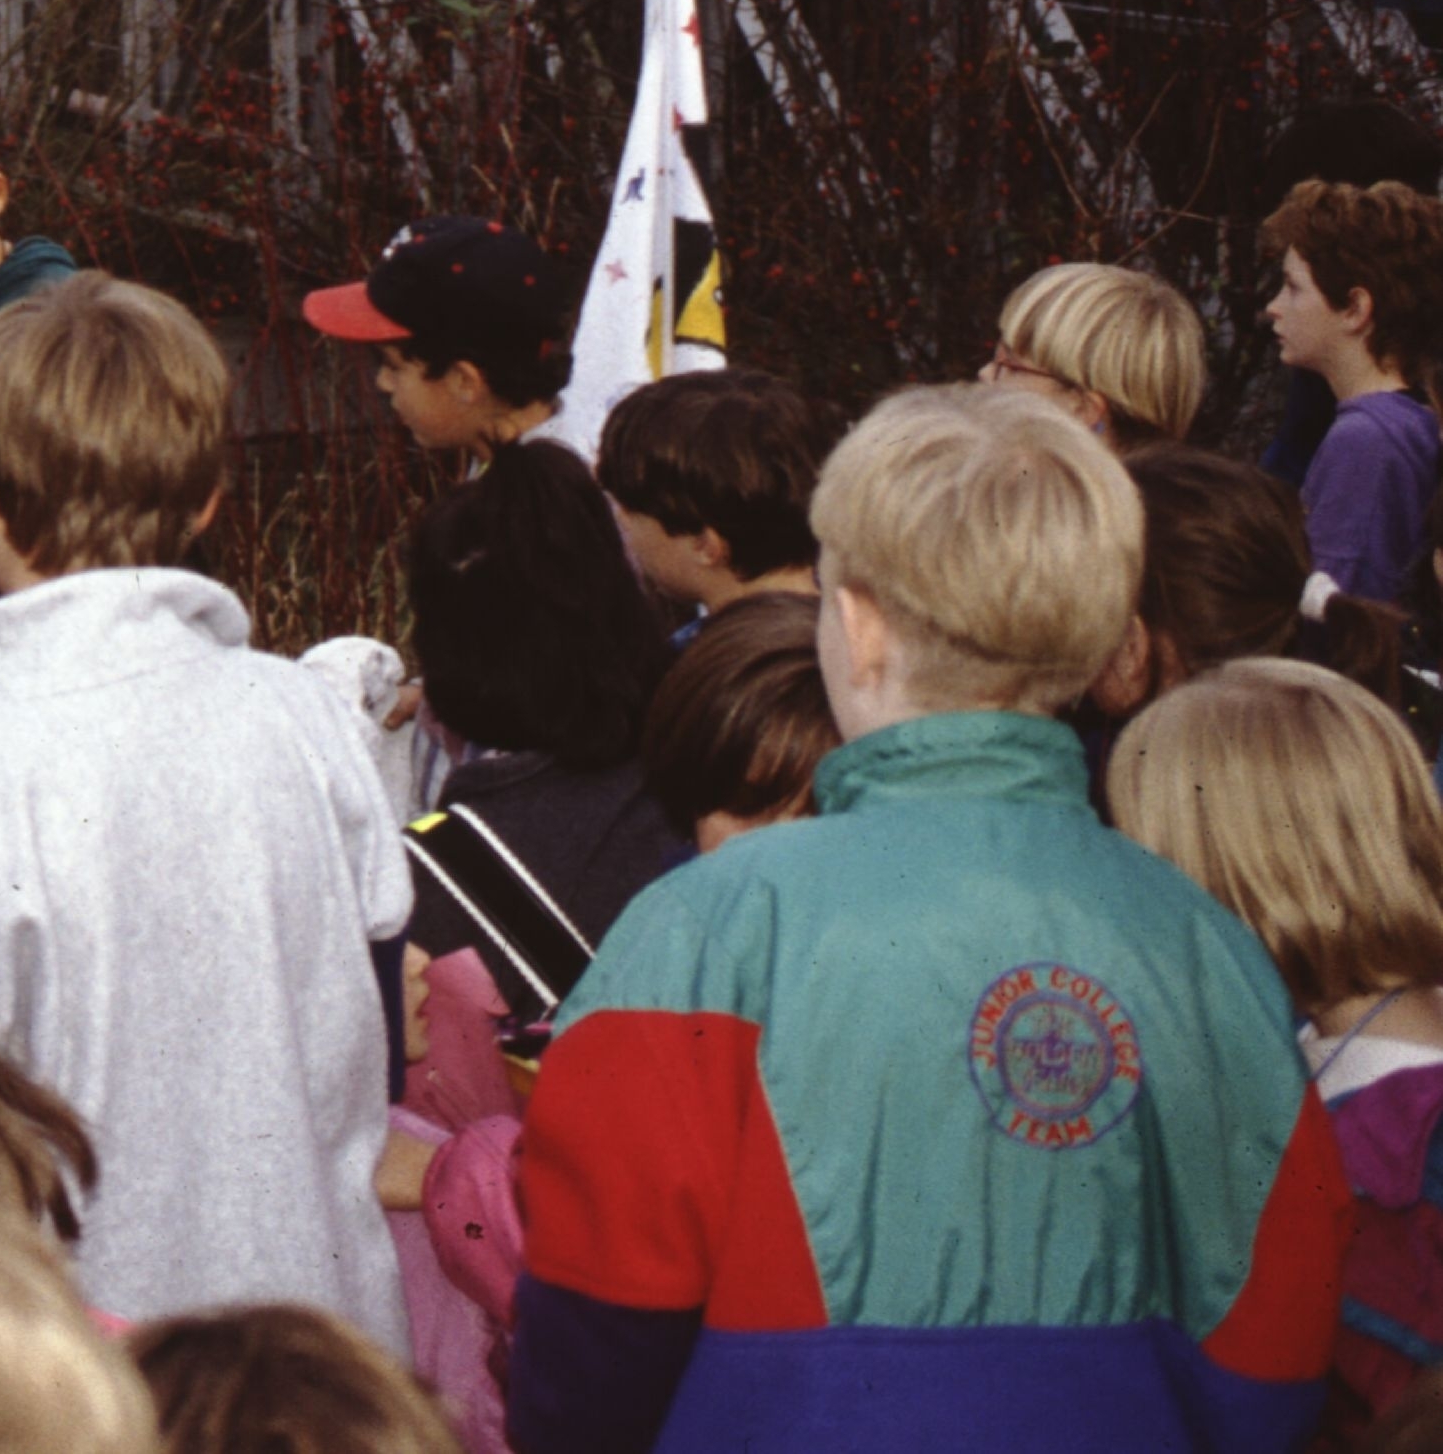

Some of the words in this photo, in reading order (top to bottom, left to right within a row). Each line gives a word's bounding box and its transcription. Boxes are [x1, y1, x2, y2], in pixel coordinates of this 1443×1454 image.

[973, 970, 1036, 1070] JUNIOR
[1050, 965, 1141, 1082] COLLEGE
[1007, 1110, 1093, 1145] TEAM
